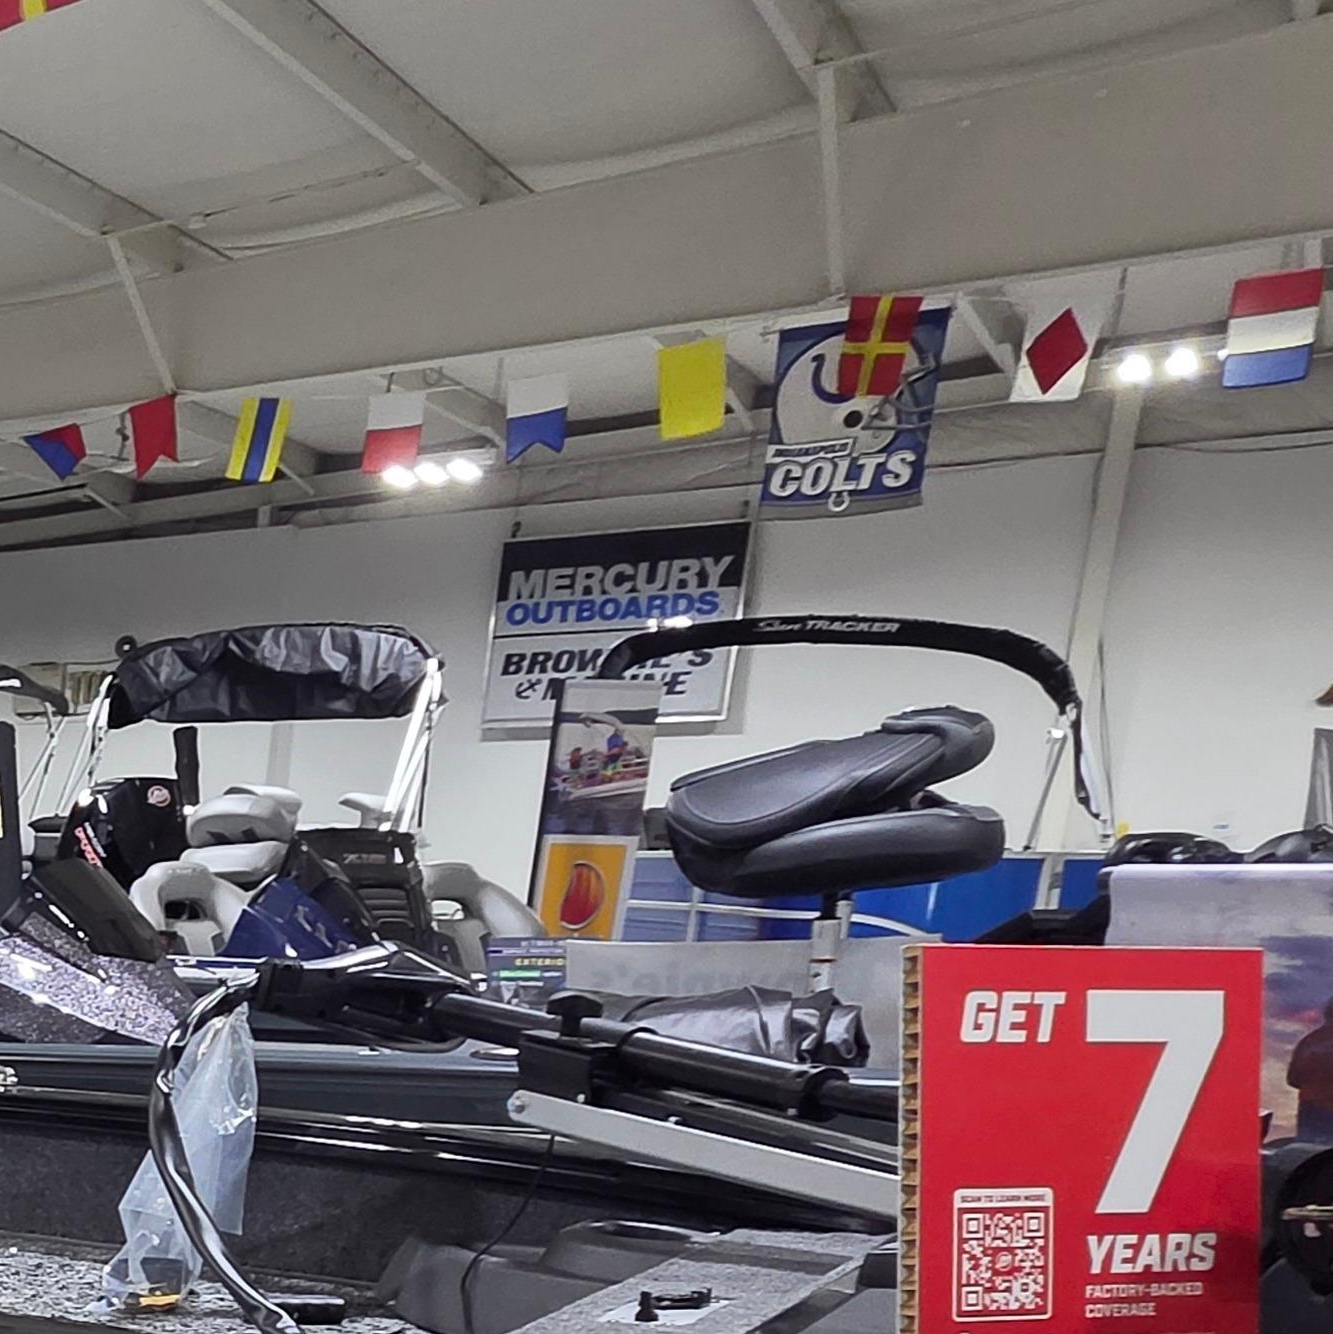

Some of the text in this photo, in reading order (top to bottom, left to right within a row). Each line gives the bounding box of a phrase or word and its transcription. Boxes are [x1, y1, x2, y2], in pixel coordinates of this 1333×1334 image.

[769, 450, 917, 497] COLTS
[507, 556, 735, 601] MERCURY
[506, 591, 720, 626] OUTBOARDS
[804, 620, 901, 633] TRACKER
[514, 957, 565, 967] EXTERIO
[960, 989, 1225, 1214] GET 7
[1086, 1233, 1217, 1274] YEARS
[1085, 1282, 1203, 1299] FACTORY-BACKED
[1085, 1303, 1157, 1318] COVERAGE
